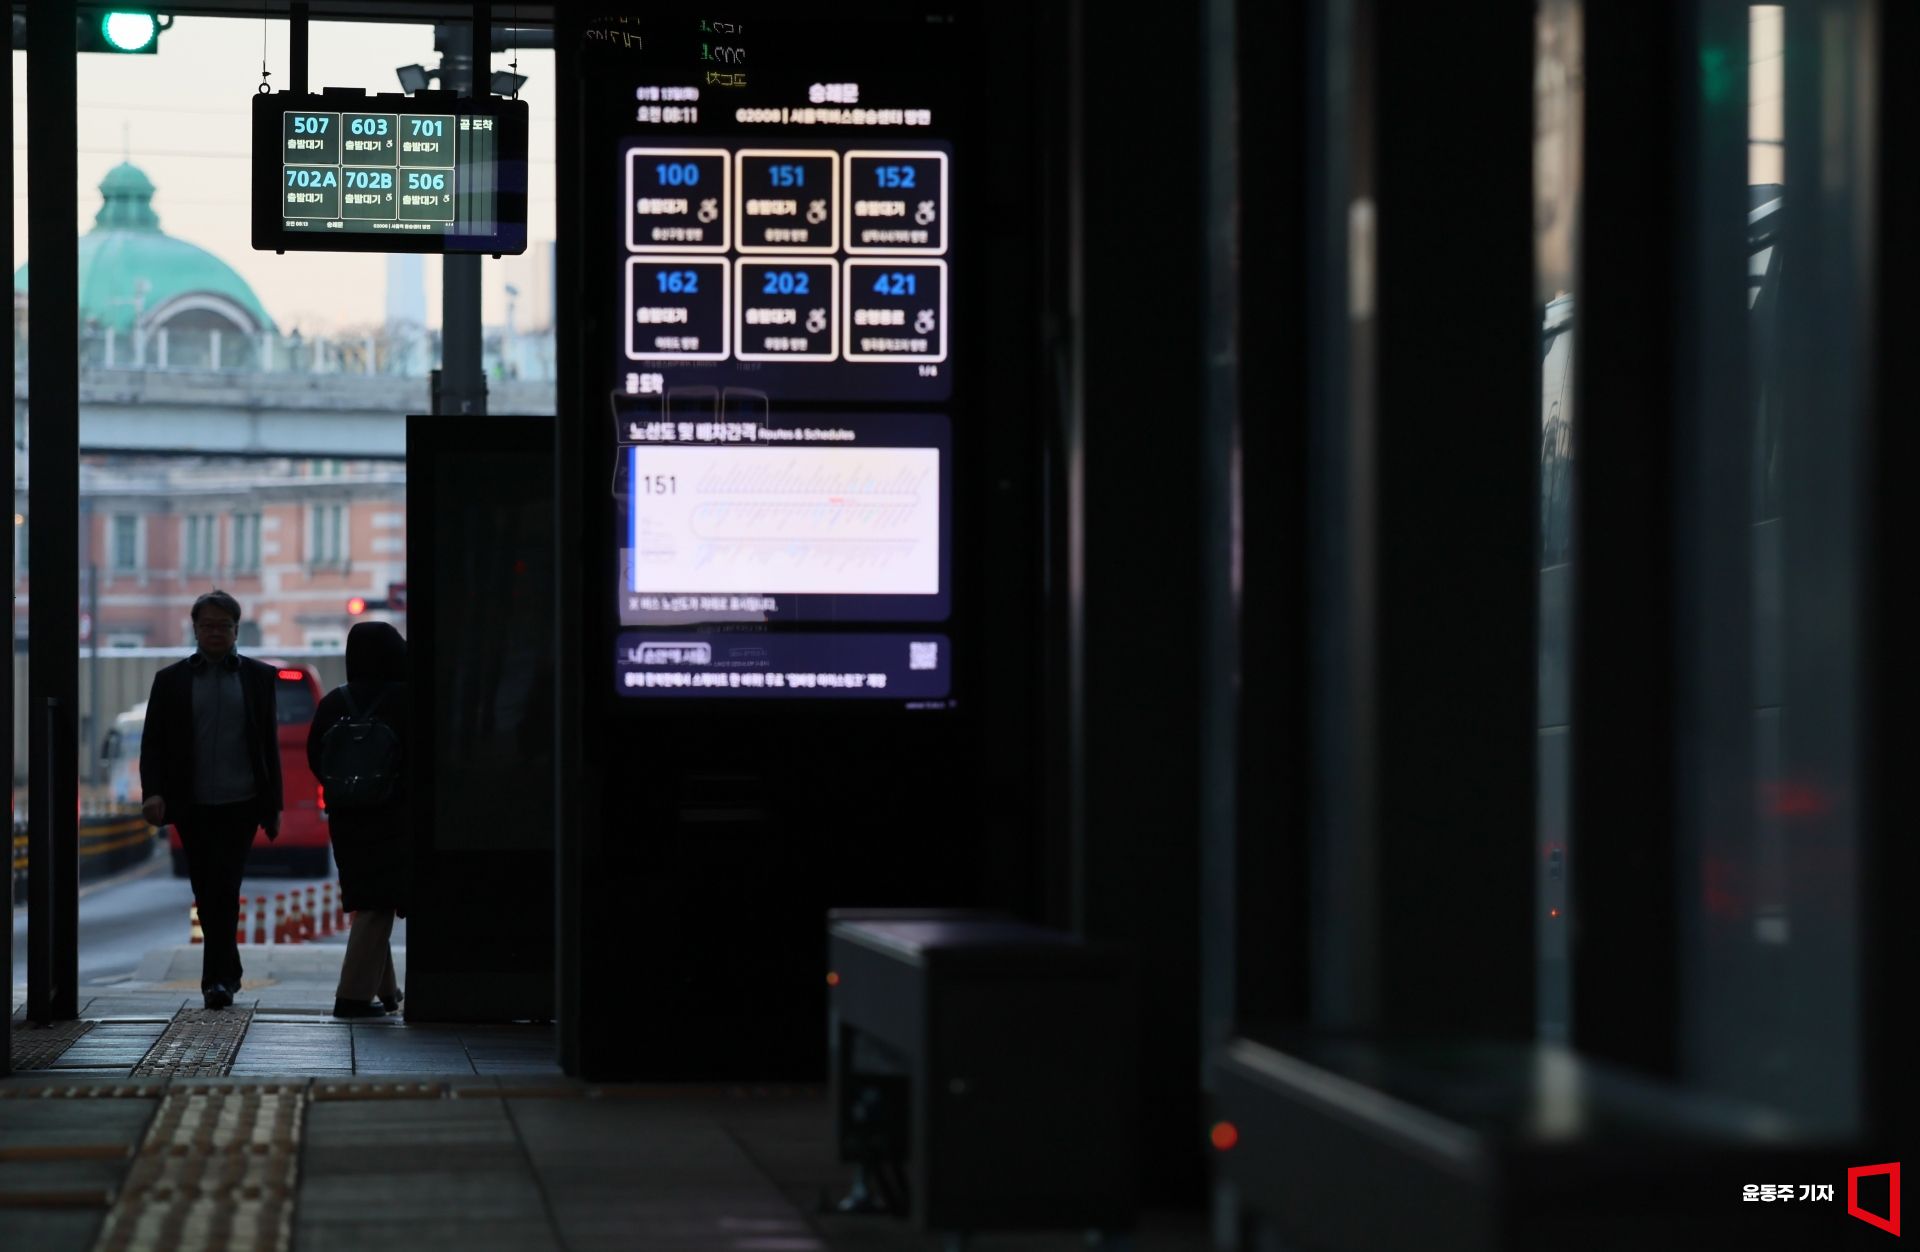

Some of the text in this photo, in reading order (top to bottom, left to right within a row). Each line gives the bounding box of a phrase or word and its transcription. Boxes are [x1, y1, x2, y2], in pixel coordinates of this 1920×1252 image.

[294, 117, 330, 134] 507
[351, 118, 388, 136] 603
[411, 119, 443, 137] 701
[472, 119, 493, 131] 도착
[287, 139, 324, 150] 출발대기
[345, 140, 382, 152] 출발대기
[403, 141, 439, 153] 출발대기
[287, 170, 337, 188] 702A
[345, 171, 392, 189] 702B
[408, 173, 444, 190] 506
[656, 163, 700, 186] 100
[769, 165, 804, 187] 151
[875, 166, 916, 189] 152
[287, 192, 323, 204] 출발대기
[345, 193, 381, 205] 출발대기
[402, 194, 438, 206] 출발대기
[656, 271, 698, 293] 162
[763, 271, 810, 294] 202
[873, 273, 916, 295] 421
[630, 422, 676, 441] 노선도
[678, 422, 694, 441] 및
[696, 422, 756, 442] 배차간격
[644, 475, 677, 495] 151
